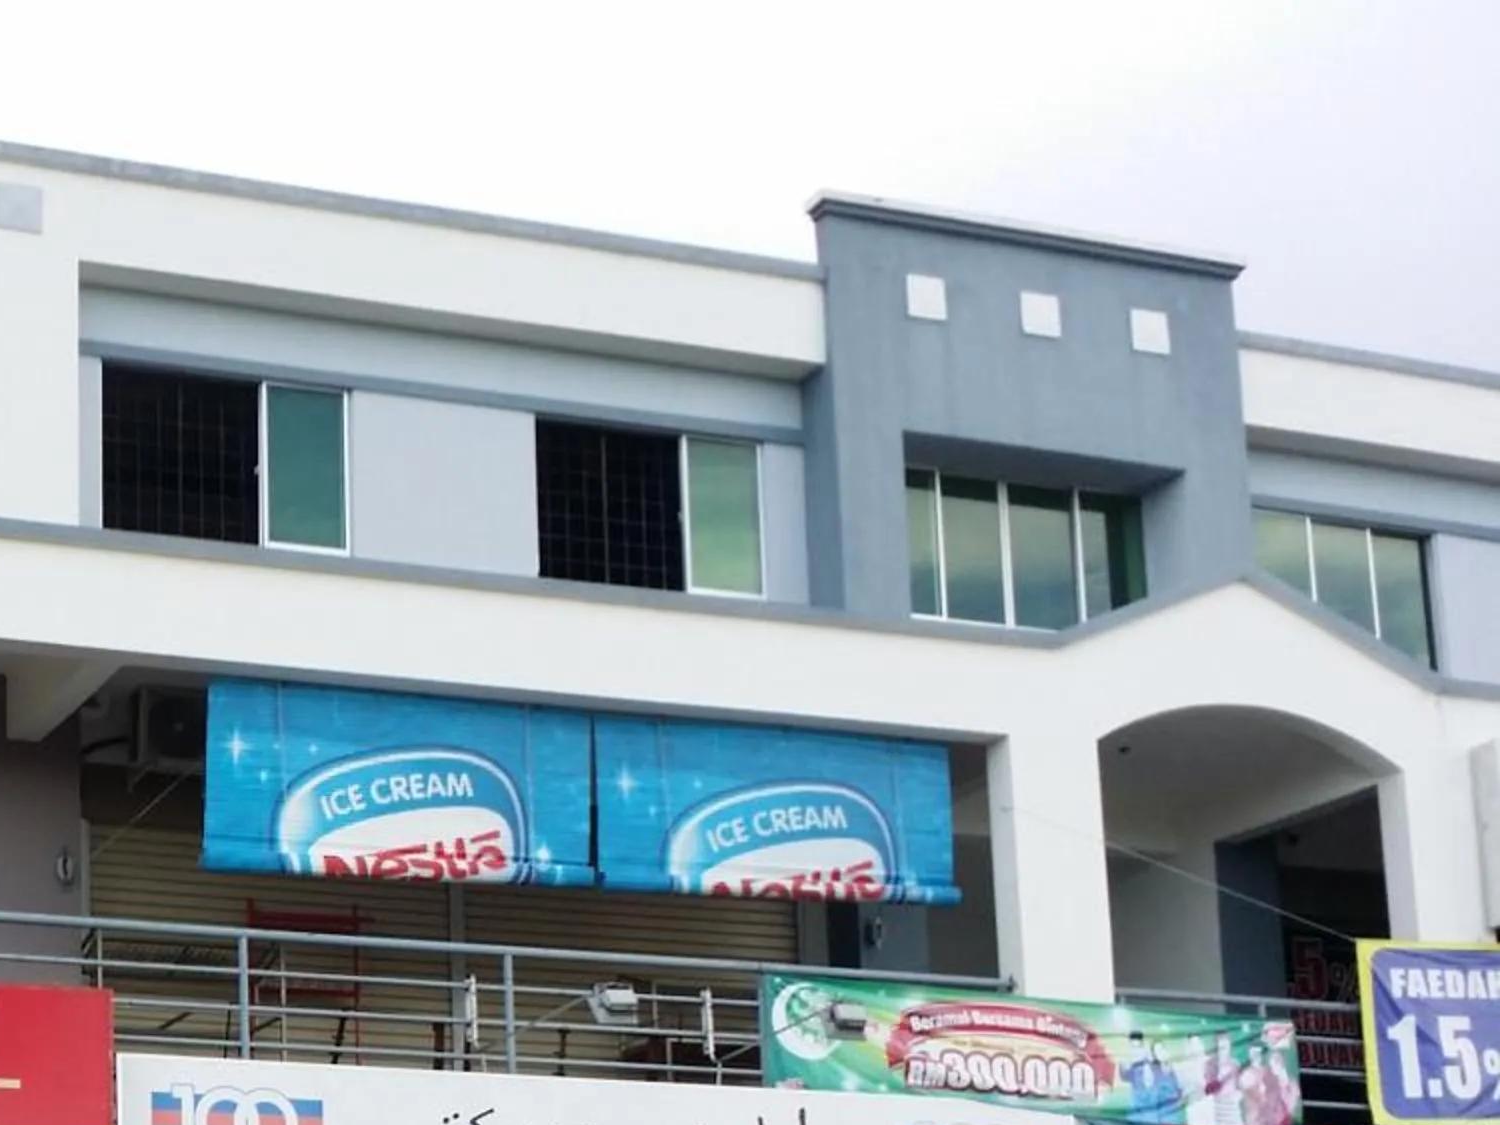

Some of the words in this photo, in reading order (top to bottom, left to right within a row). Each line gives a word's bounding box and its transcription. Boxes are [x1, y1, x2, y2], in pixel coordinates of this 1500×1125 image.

[320, 787, 365, 820] ICE
[370, 773, 474, 806] CREAM
[705, 816, 751, 853] ICE
[753, 805, 848, 838] CREAM
